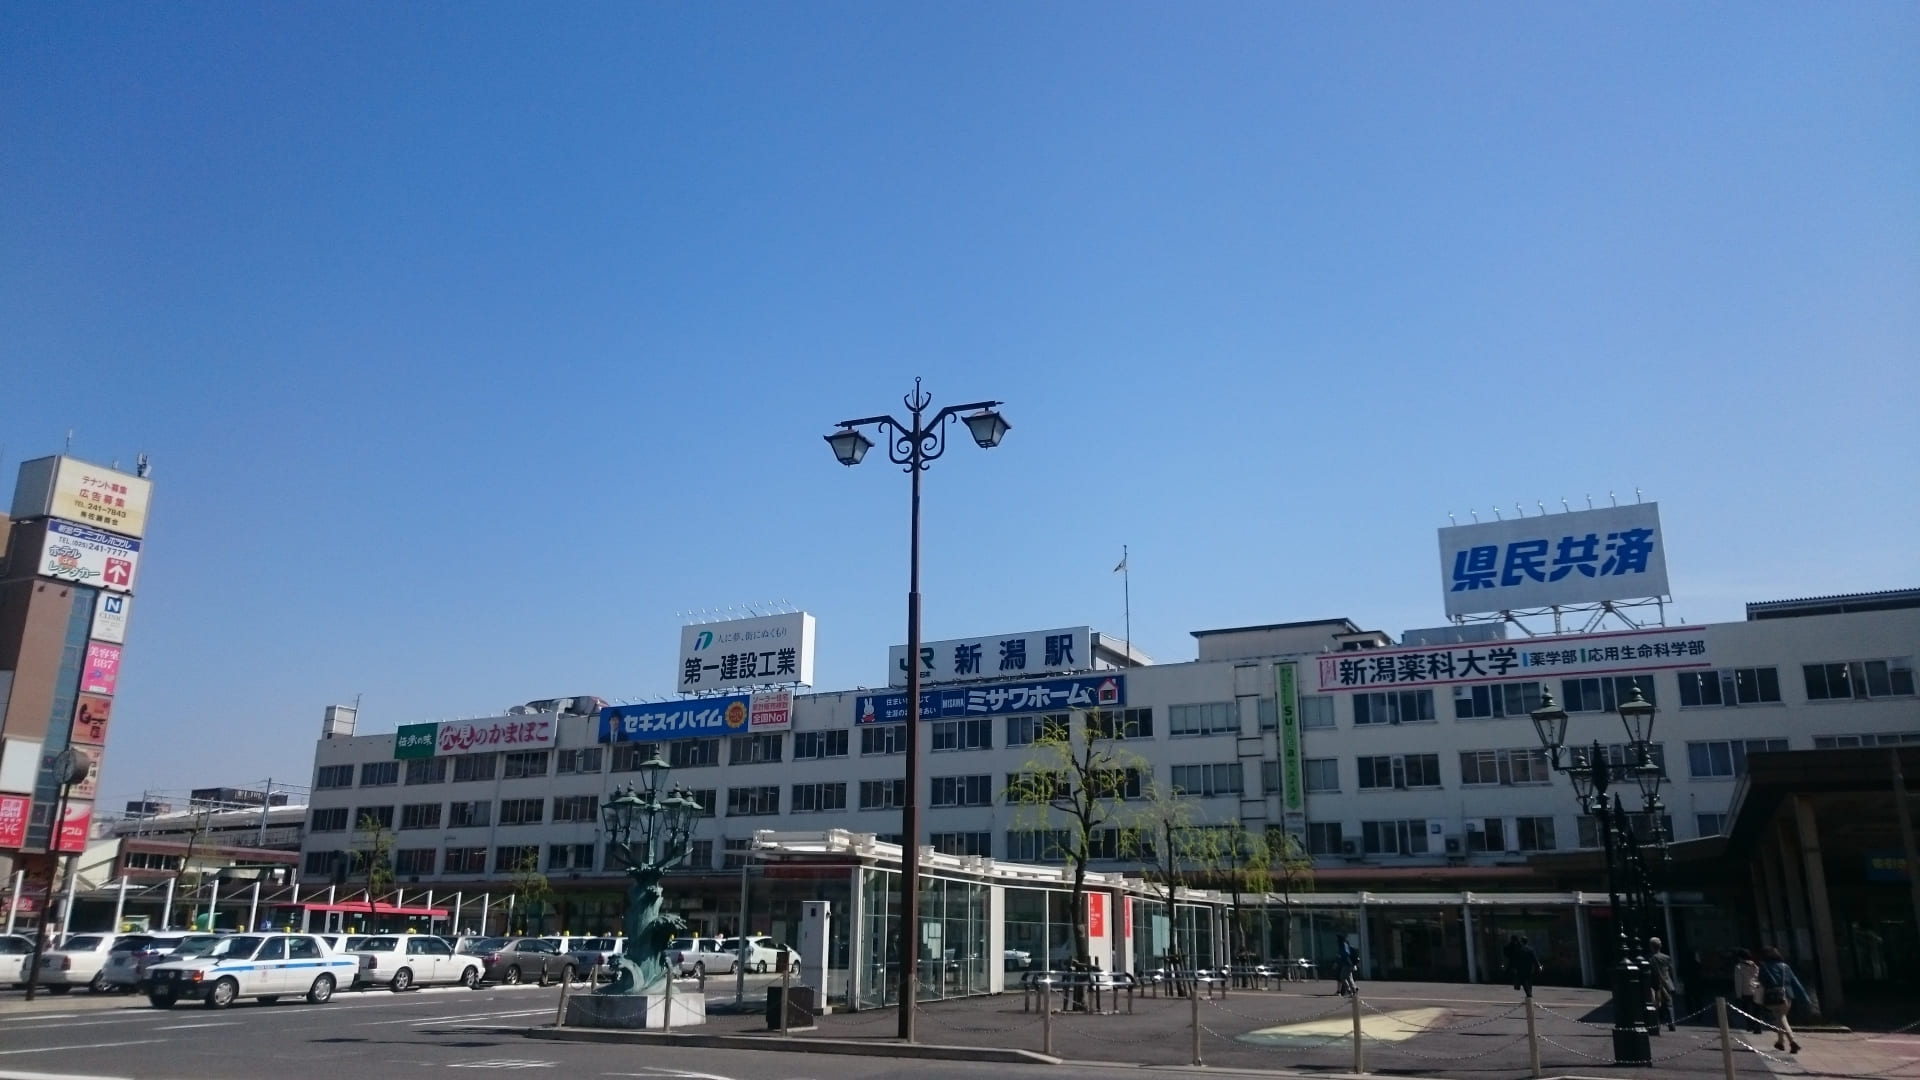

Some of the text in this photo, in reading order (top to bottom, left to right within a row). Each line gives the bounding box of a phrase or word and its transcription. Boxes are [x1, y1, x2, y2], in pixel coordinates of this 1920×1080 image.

[79, 488, 126, 508] 広告募集
[88, 503, 127, 518] 241-7843
[49, 545, 82, 559] ホテル
[1450, 528, 1654, 592] 県民共済
[48, 561, 101, 578] レンタカー
[108, 600, 120, 612] N
[89, 646, 120, 661] 美容室
[684, 648, 796, 684] 第一建設工業
[955, 634, 1075, 675] 新潟駅
[1340, 640, 1706, 685] 新潟薬科大学 薬学部 応用生命科学部
[967, 683, 1093, 713] ミサワホーム
[624, 708, 722, 733] セキスイハイム
[439, 722, 549, 751] 伏見のかまぼこ
